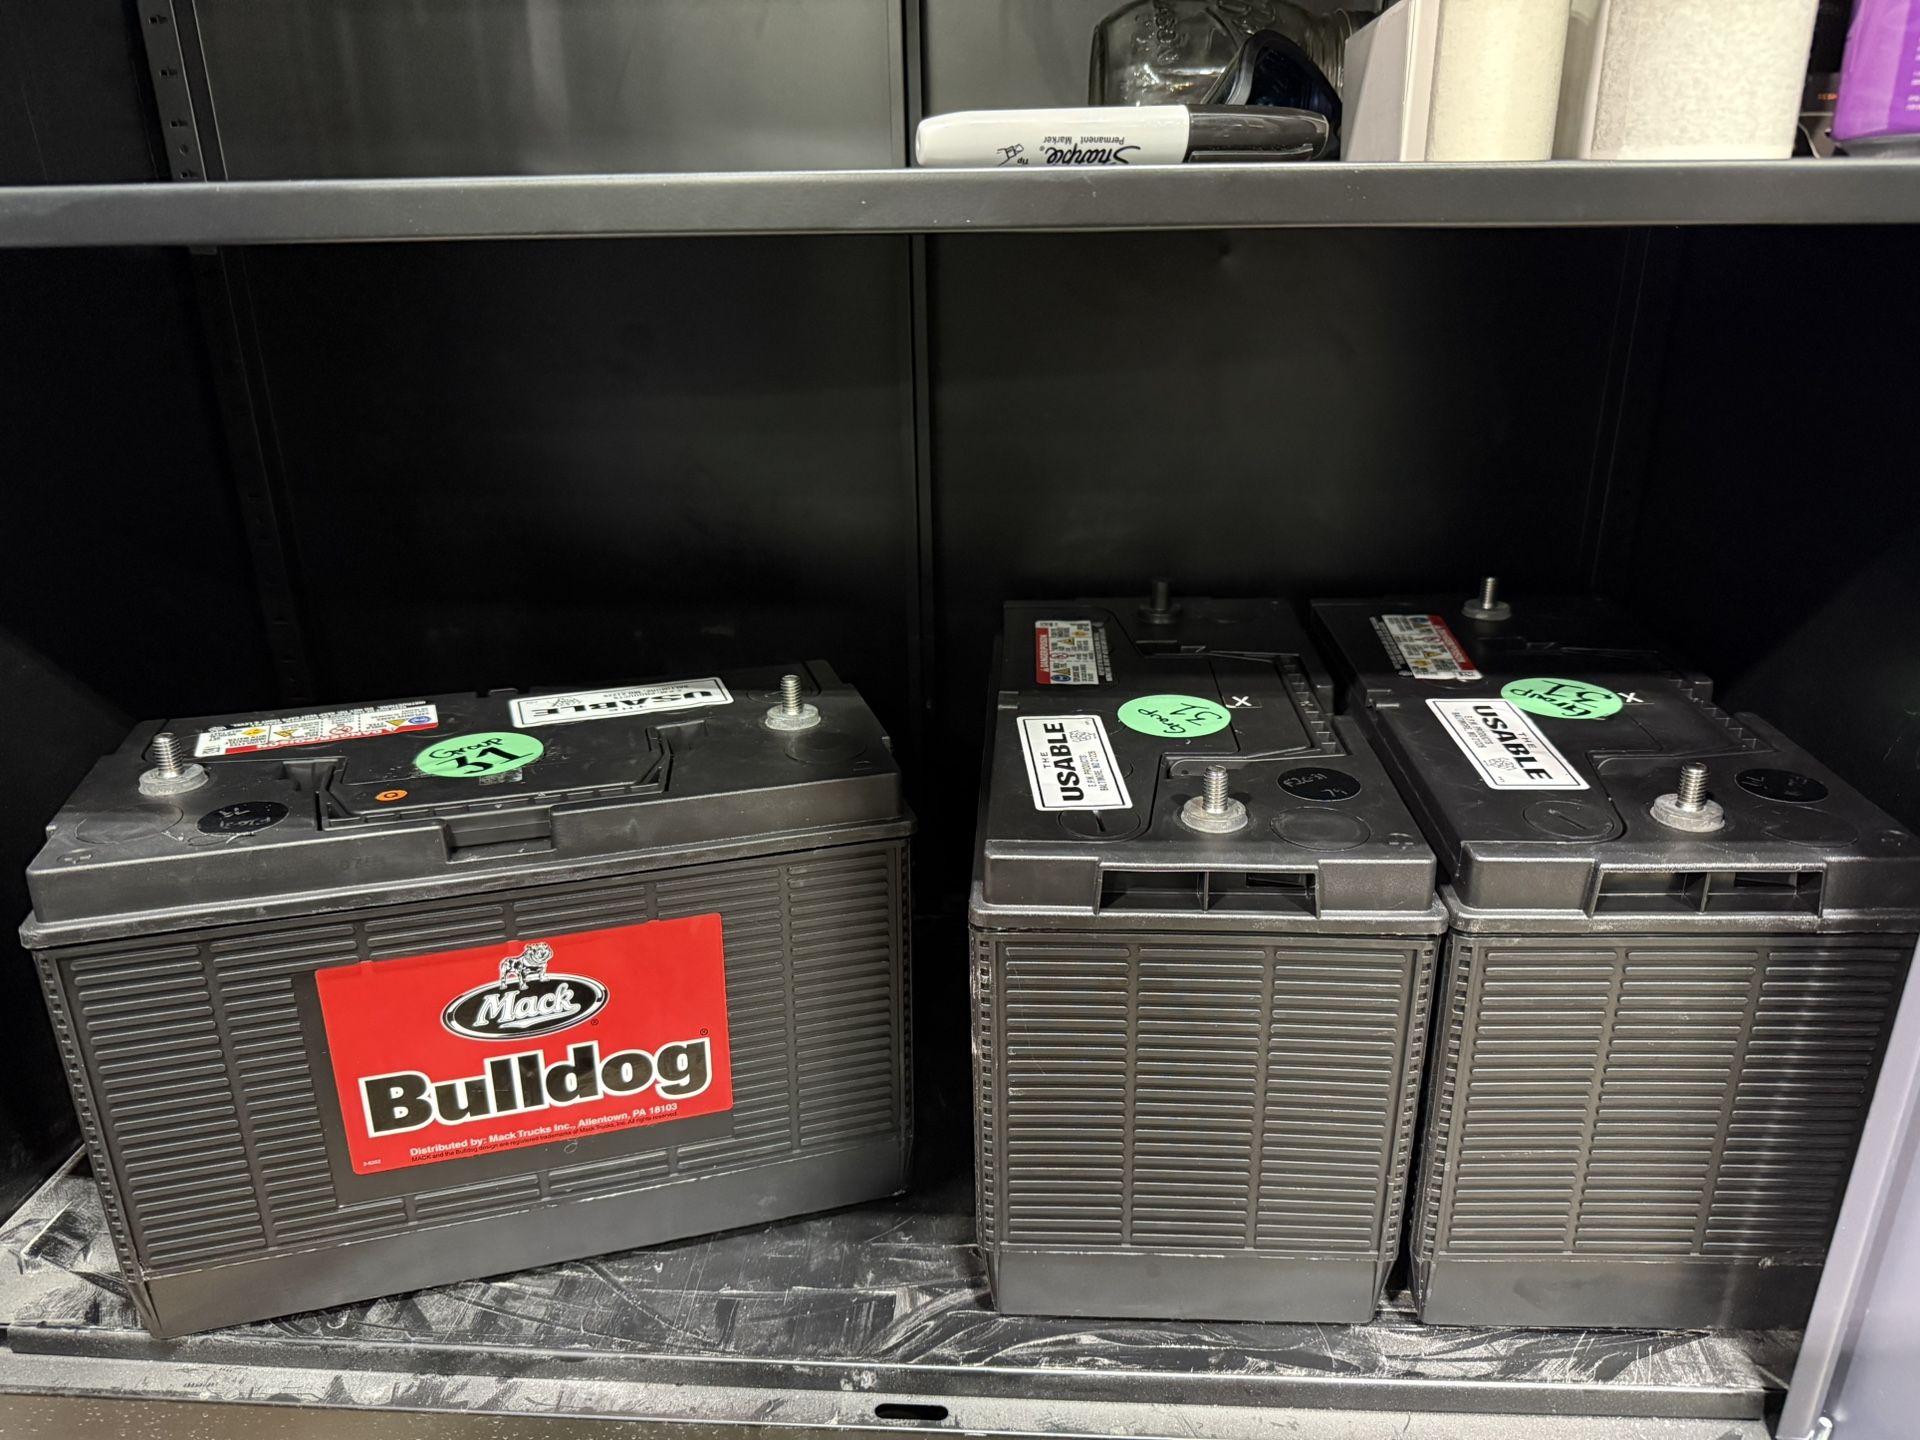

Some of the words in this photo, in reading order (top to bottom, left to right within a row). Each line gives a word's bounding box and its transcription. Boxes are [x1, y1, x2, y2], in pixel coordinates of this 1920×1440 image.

[1043, 136, 1073, 145] Marker
[1045, 143, 1141, 165] Sharpie
[1080, 136, 1125, 145] Permanent
[532, 690, 713, 717] USABLE
[608, 704, 645, 712] THE
[1510, 688, 1592, 717] Group
[1541, 680, 1612, 709] 31
[1138, 708, 1186, 734] Group
[1169, 702, 1223, 726] 31
[429, 737, 503, 761] Group
[1473, 705, 1554, 780] USABLE
[1518, 732, 1537, 749] THE
[436, 746, 534, 775] 31
[1039, 751, 1052, 769] THE
[1043, 723, 1085, 801] USABLE
[473, 982, 580, 1027] Mack
[358, 1037, 712, 1139] Bulldog
[409, 1138, 468, 1156] Distributed
[470, 1137, 487, 1147] by:
[489, 1132, 517, 1143] Mack
[517, 1126, 552, 1138] Trucks
[553, 1123, 577, 1132] Inc.,
[578, 1110, 631, 1128] Allentown,
[632, 1109, 647, 1118] PA
[648, 1102, 678, 1115] 18103
[411, 1154, 431, 1162] MACK
[455, 1146, 478, 1156] Bulldog
[580, 1126, 595, 1134] Mack
